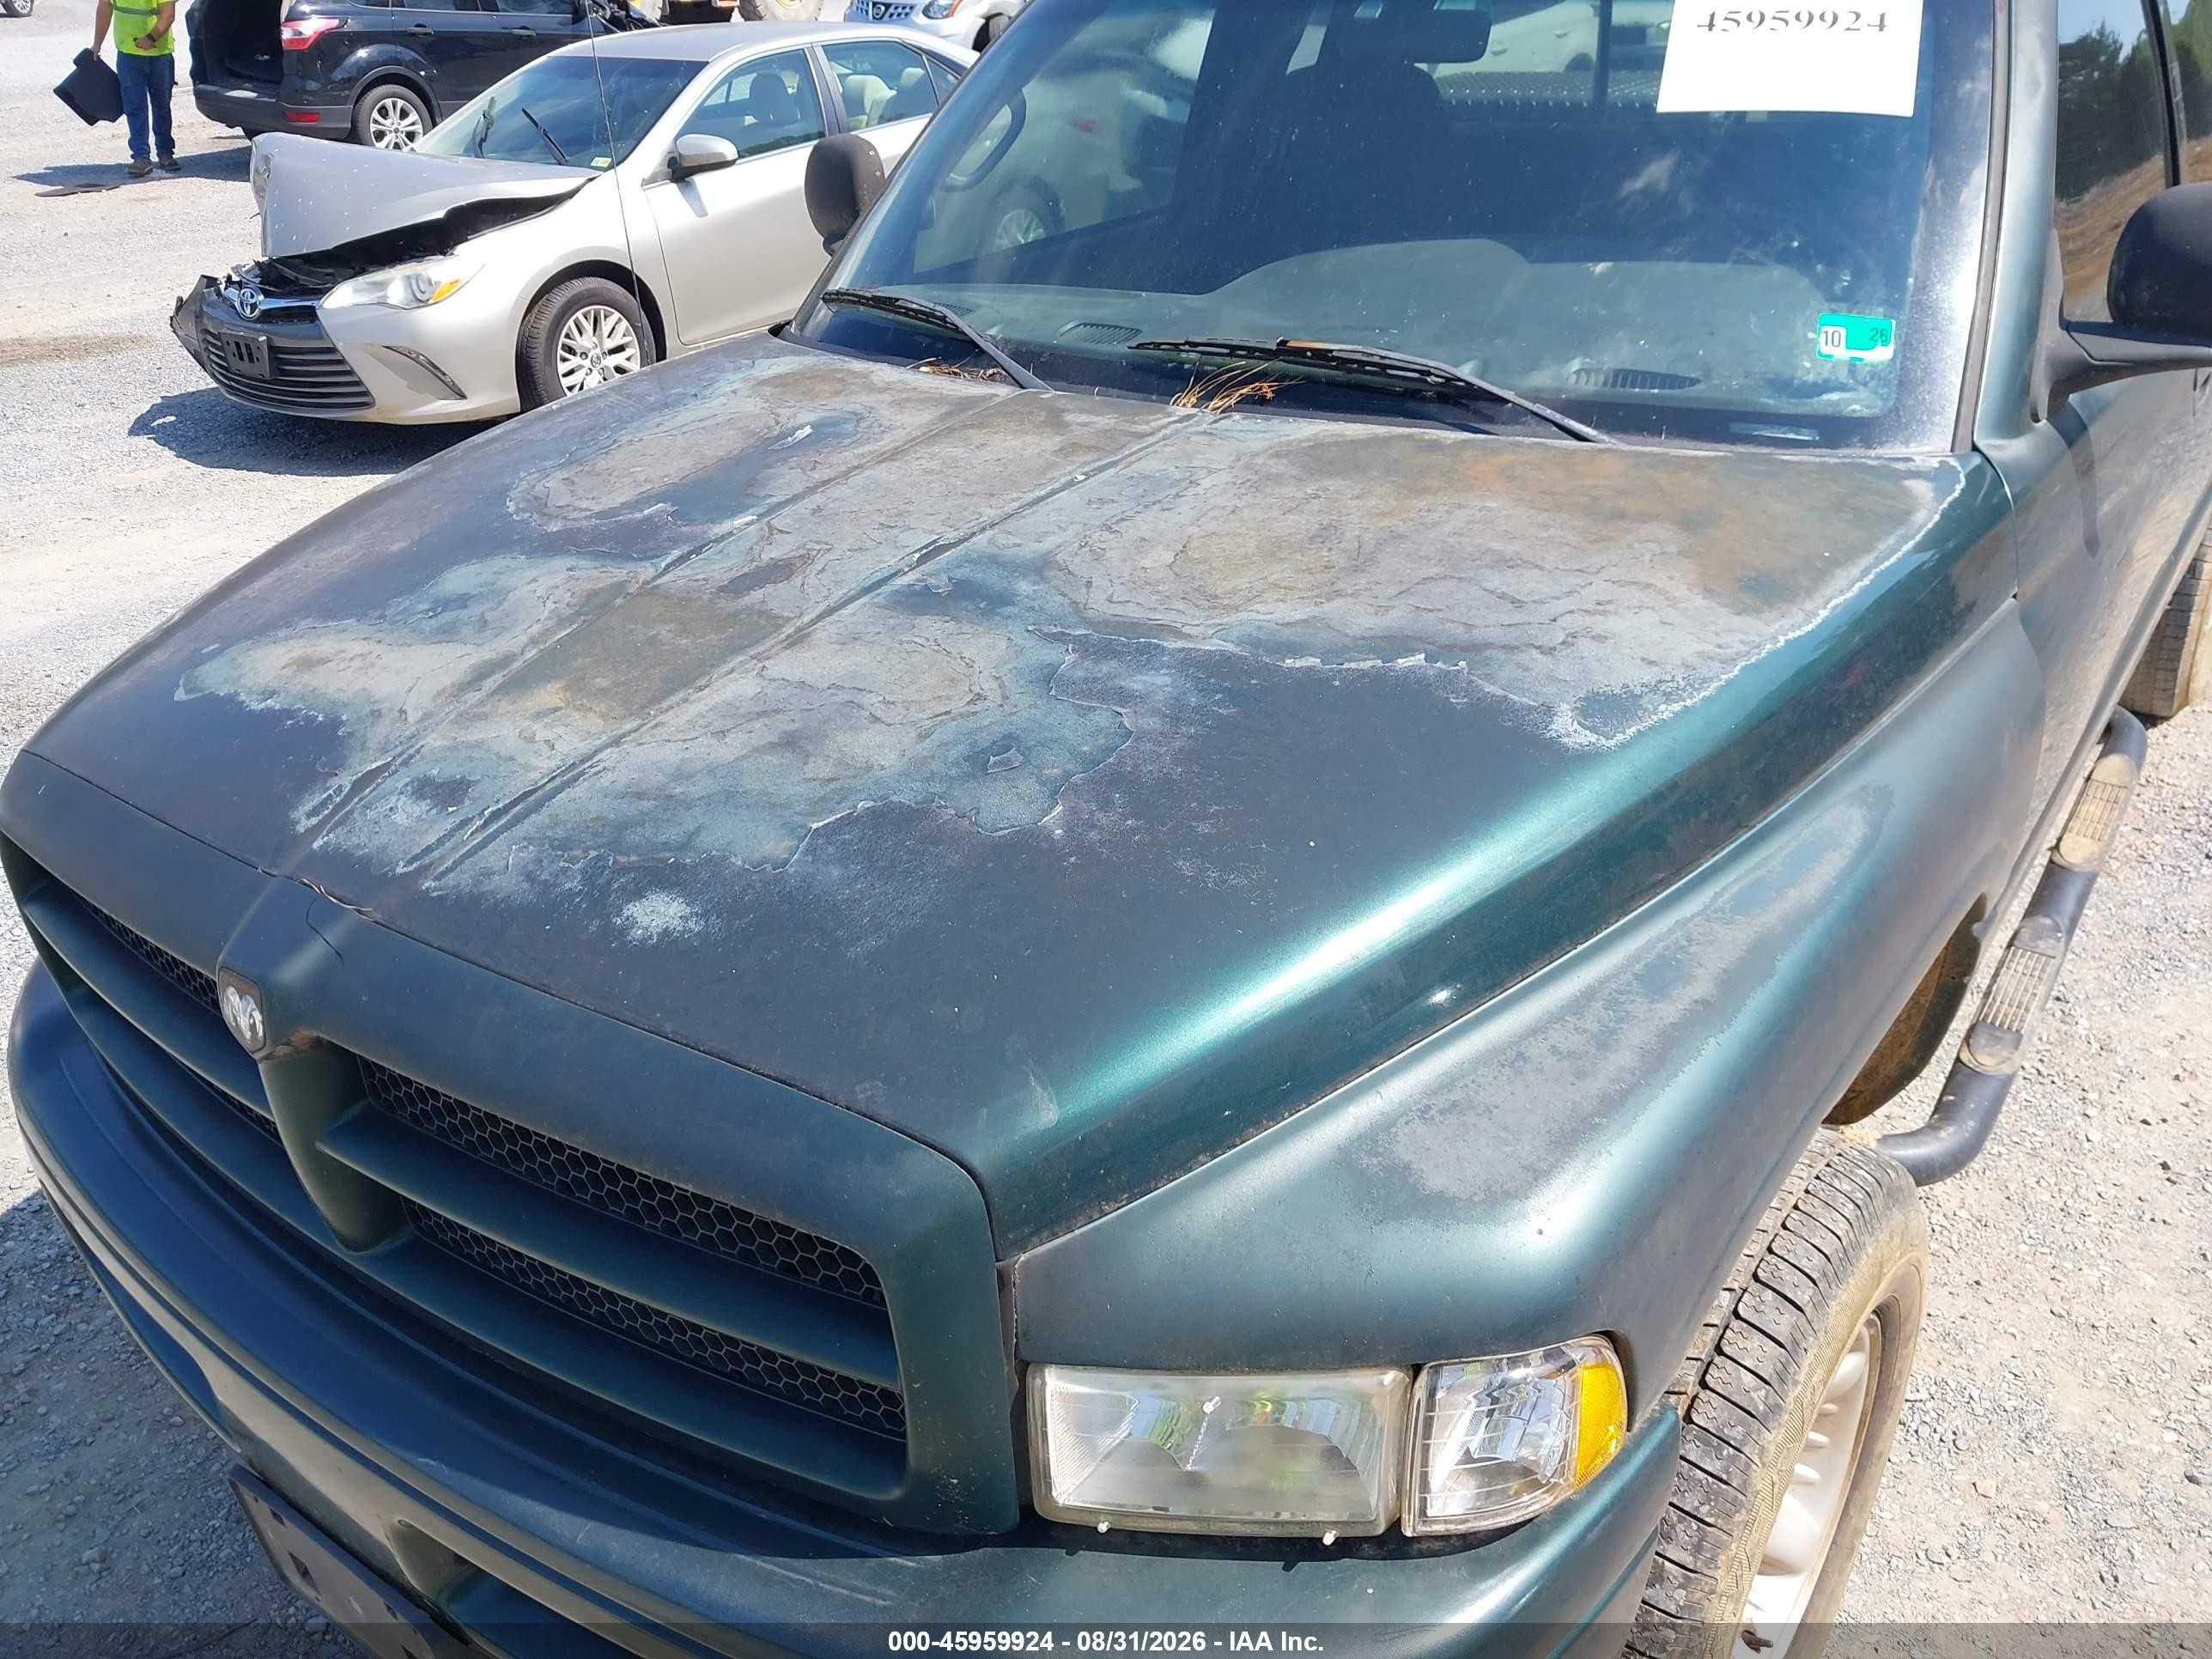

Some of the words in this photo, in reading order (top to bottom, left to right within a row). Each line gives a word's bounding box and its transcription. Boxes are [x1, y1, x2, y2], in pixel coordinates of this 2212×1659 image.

[1697, 10, 1887, 32] 45959924
[1823, 330, 1842, 348] 10
[1869, 327, 1889, 343] 26
